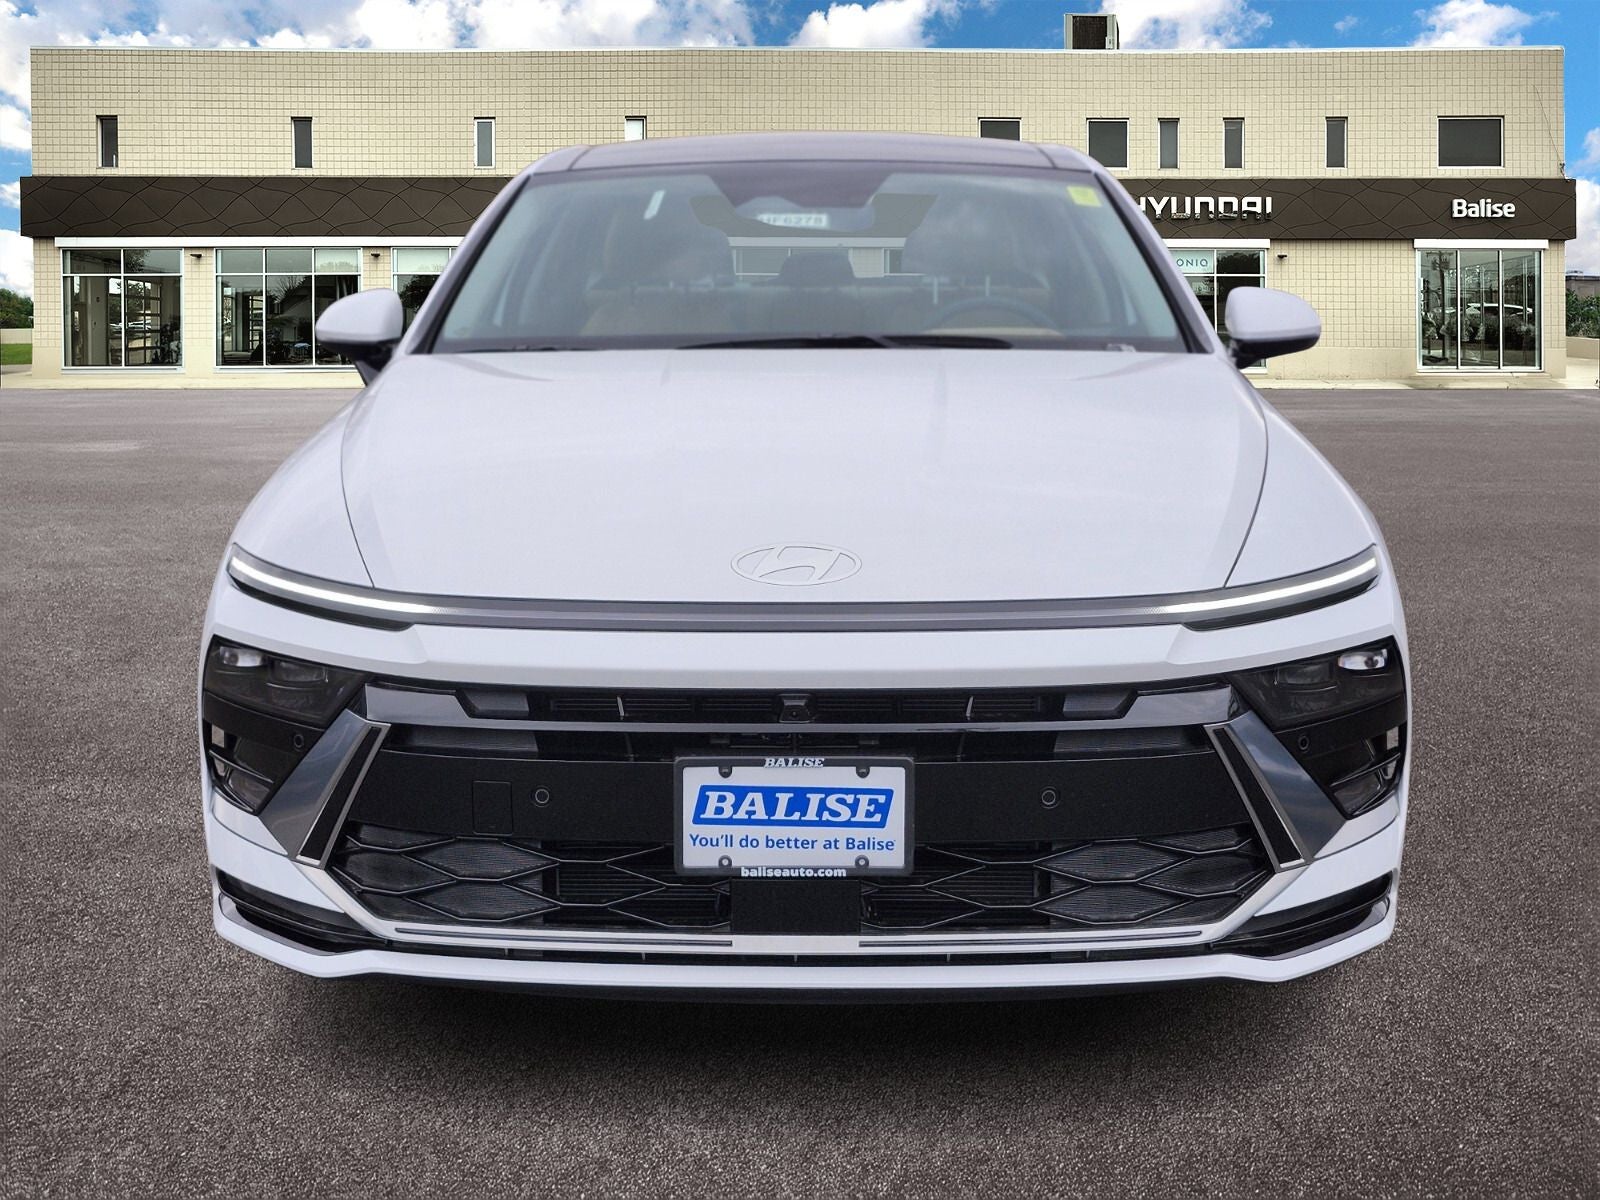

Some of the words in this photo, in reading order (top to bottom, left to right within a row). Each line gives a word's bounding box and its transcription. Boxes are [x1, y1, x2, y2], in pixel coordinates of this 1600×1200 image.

[1452, 198, 1515, 218] Balise
[1176, 258, 1209, 267] ONIQ
[763, 757, 825, 768] BALISE
[699, 790, 887, 823] BALISE
[689, 833, 734, 848] You'll
[739, 834, 760, 849] do
[765, 835, 818, 850] better
[823, 837, 841, 850] at
[845, 838, 895, 851] Balise
[740, 866, 847, 878] baliseauto.com
